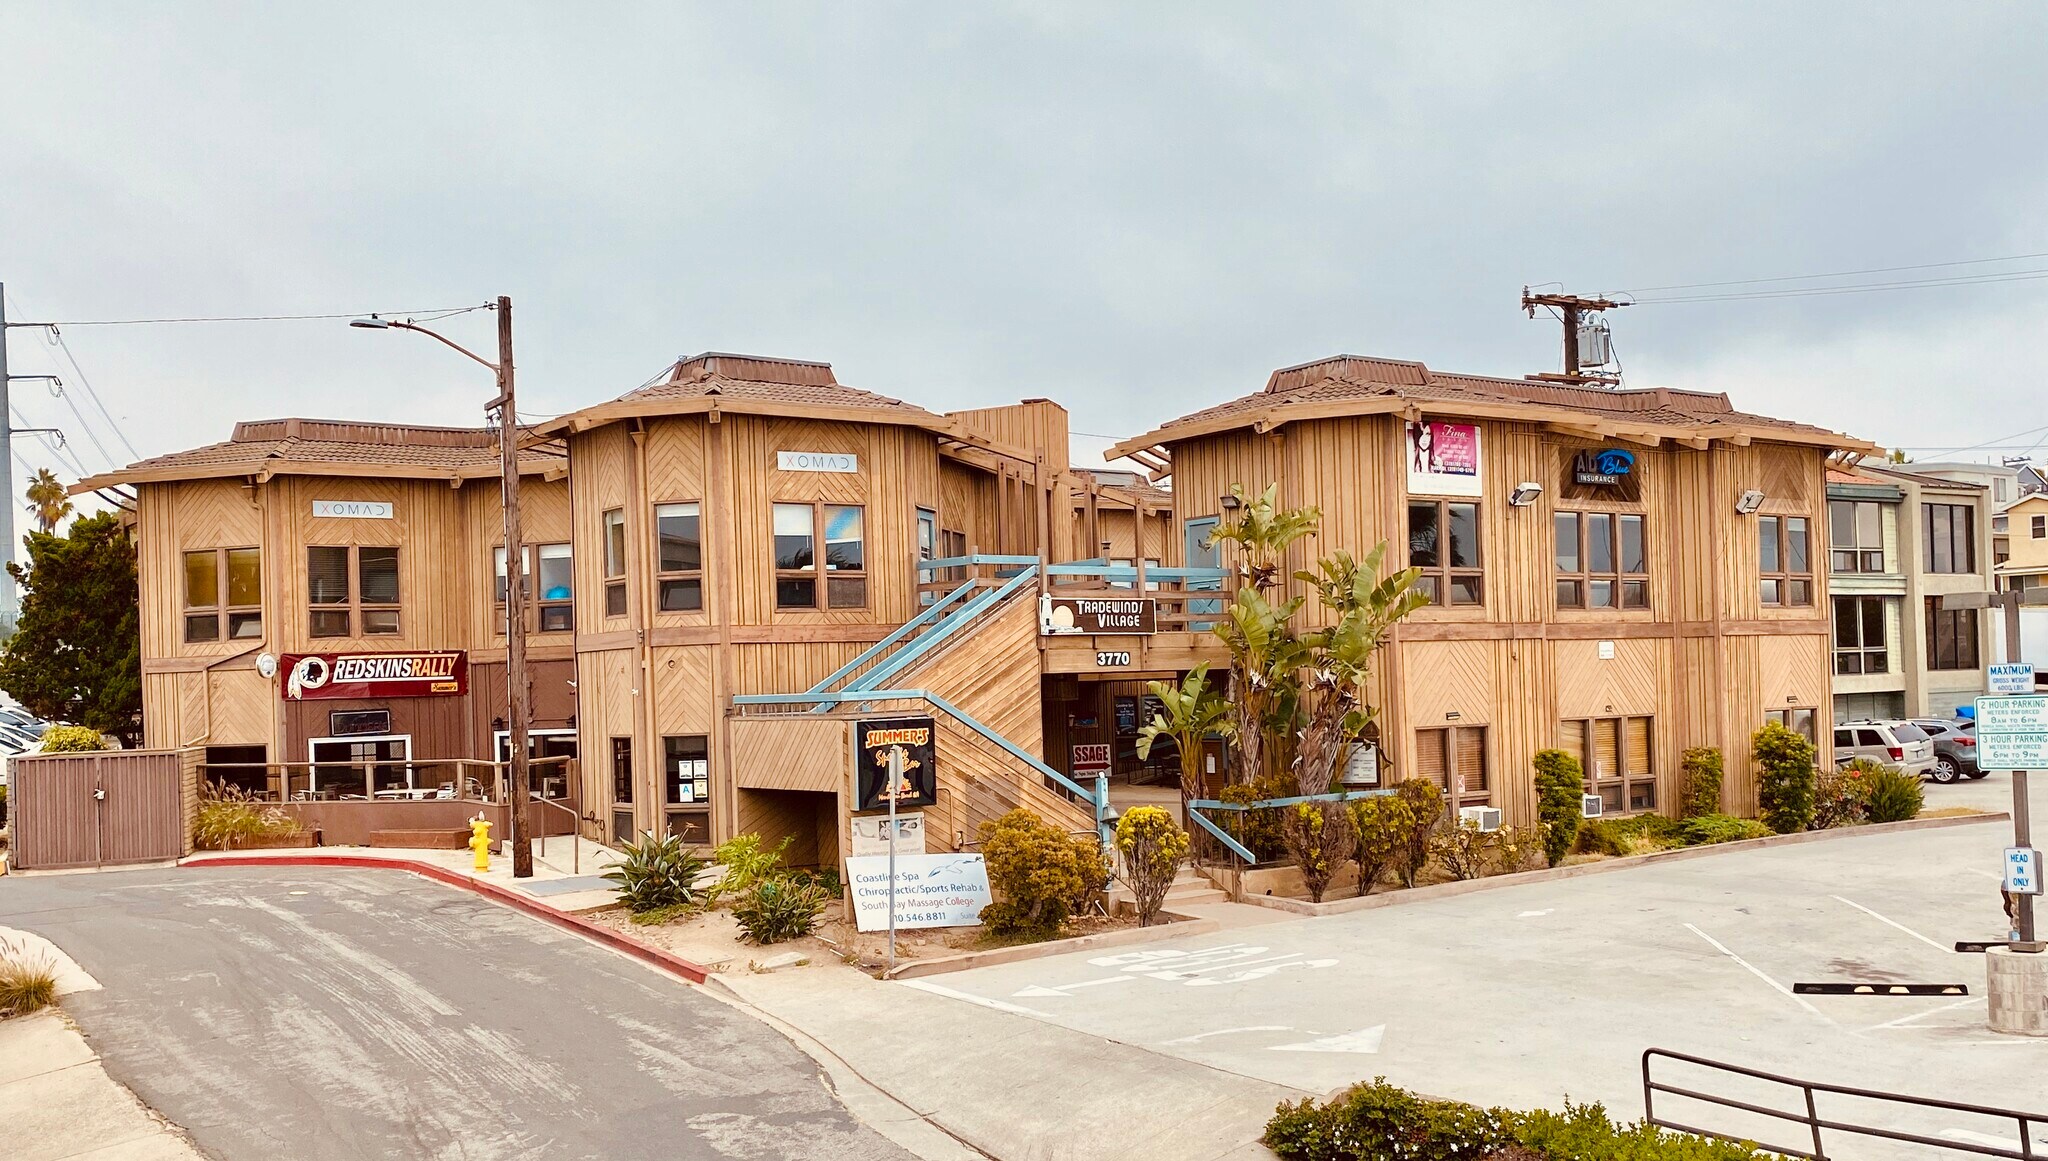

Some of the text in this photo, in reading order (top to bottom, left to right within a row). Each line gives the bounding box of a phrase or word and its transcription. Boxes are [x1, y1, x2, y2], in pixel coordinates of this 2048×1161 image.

[786, 455, 850, 470] XOMAD
[1601, 456, 1630, 475] Blue
[1580, 474, 1616, 483] INSURANCE
[321, 503, 385, 516] XOMAD
[1075, 600, 1144, 615] TRADEWINDS
[1097, 613, 1140, 629] VILLAGE
[1097, 652, 1130, 666] 3770
[1990, 665, 2032, 675] MAXIMUM
[1980, 699, 2046, 709] 2 HOUR PARKING
[865, 728, 930, 749] SUMMER'S
[1982, 734, 2048, 743] 3 HOUR PARKING
[683, 785, 690, 793] A
[2010, 854, 2028, 863] HEAD
[2016, 866, 2024, 874] IN
[901, 872, 920, 882] Spa
[2013, 878, 2030, 886] ONLY
[858, 884, 949, 897] Chiropactic/Sports
[950, 883, 978, 892] Rehab
[861, 897, 975, 911] South ay Massage College
[889, 912, 946, 923] 10.546.8811
